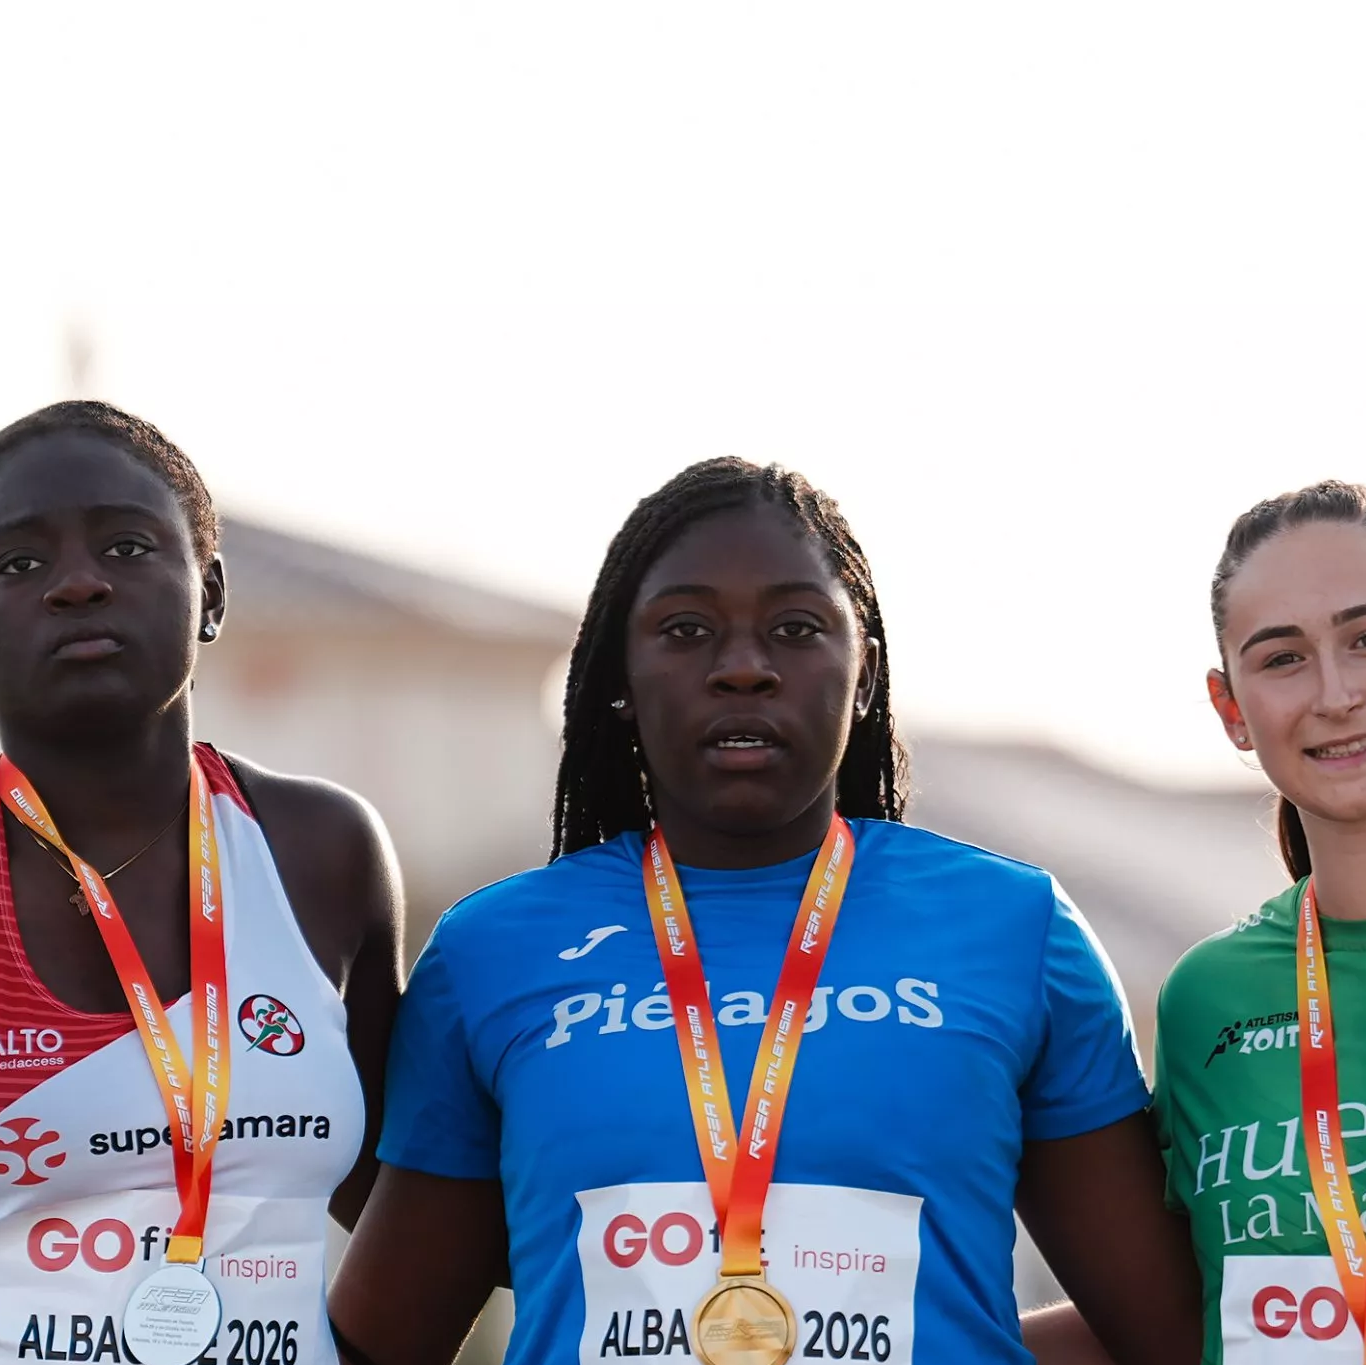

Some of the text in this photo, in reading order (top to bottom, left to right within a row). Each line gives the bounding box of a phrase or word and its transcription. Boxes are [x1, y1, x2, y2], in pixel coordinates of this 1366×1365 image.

[649, 839, 685, 956] RFEA ATLETISMO
[800, 832, 847, 954] RFEA ATLETISMO
[1245, 1011, 1299, 1029] ATLETISM
[1305, 897, 1323, 1049] RFEA ATLETISMO
[132, 983, 182, 1089] ATLETISMO
[199, 982, 219, 1152] RFEA ATLETISMO
[685, 1004, 728, 1161] RFEA ATLETISMO
[748, 1000, 797, 1160] RFEA ATLETISMO
[1239, 1024, 1300, 1055] ZOIT
[1316, 1110, 1365, 1278] RFEA ATLETISMO
[219, 1253, 298, 1284] inspira
[794, 1244, 886, 1276] inspira
[600, 1308, 891, 1363] ALBA 2026
